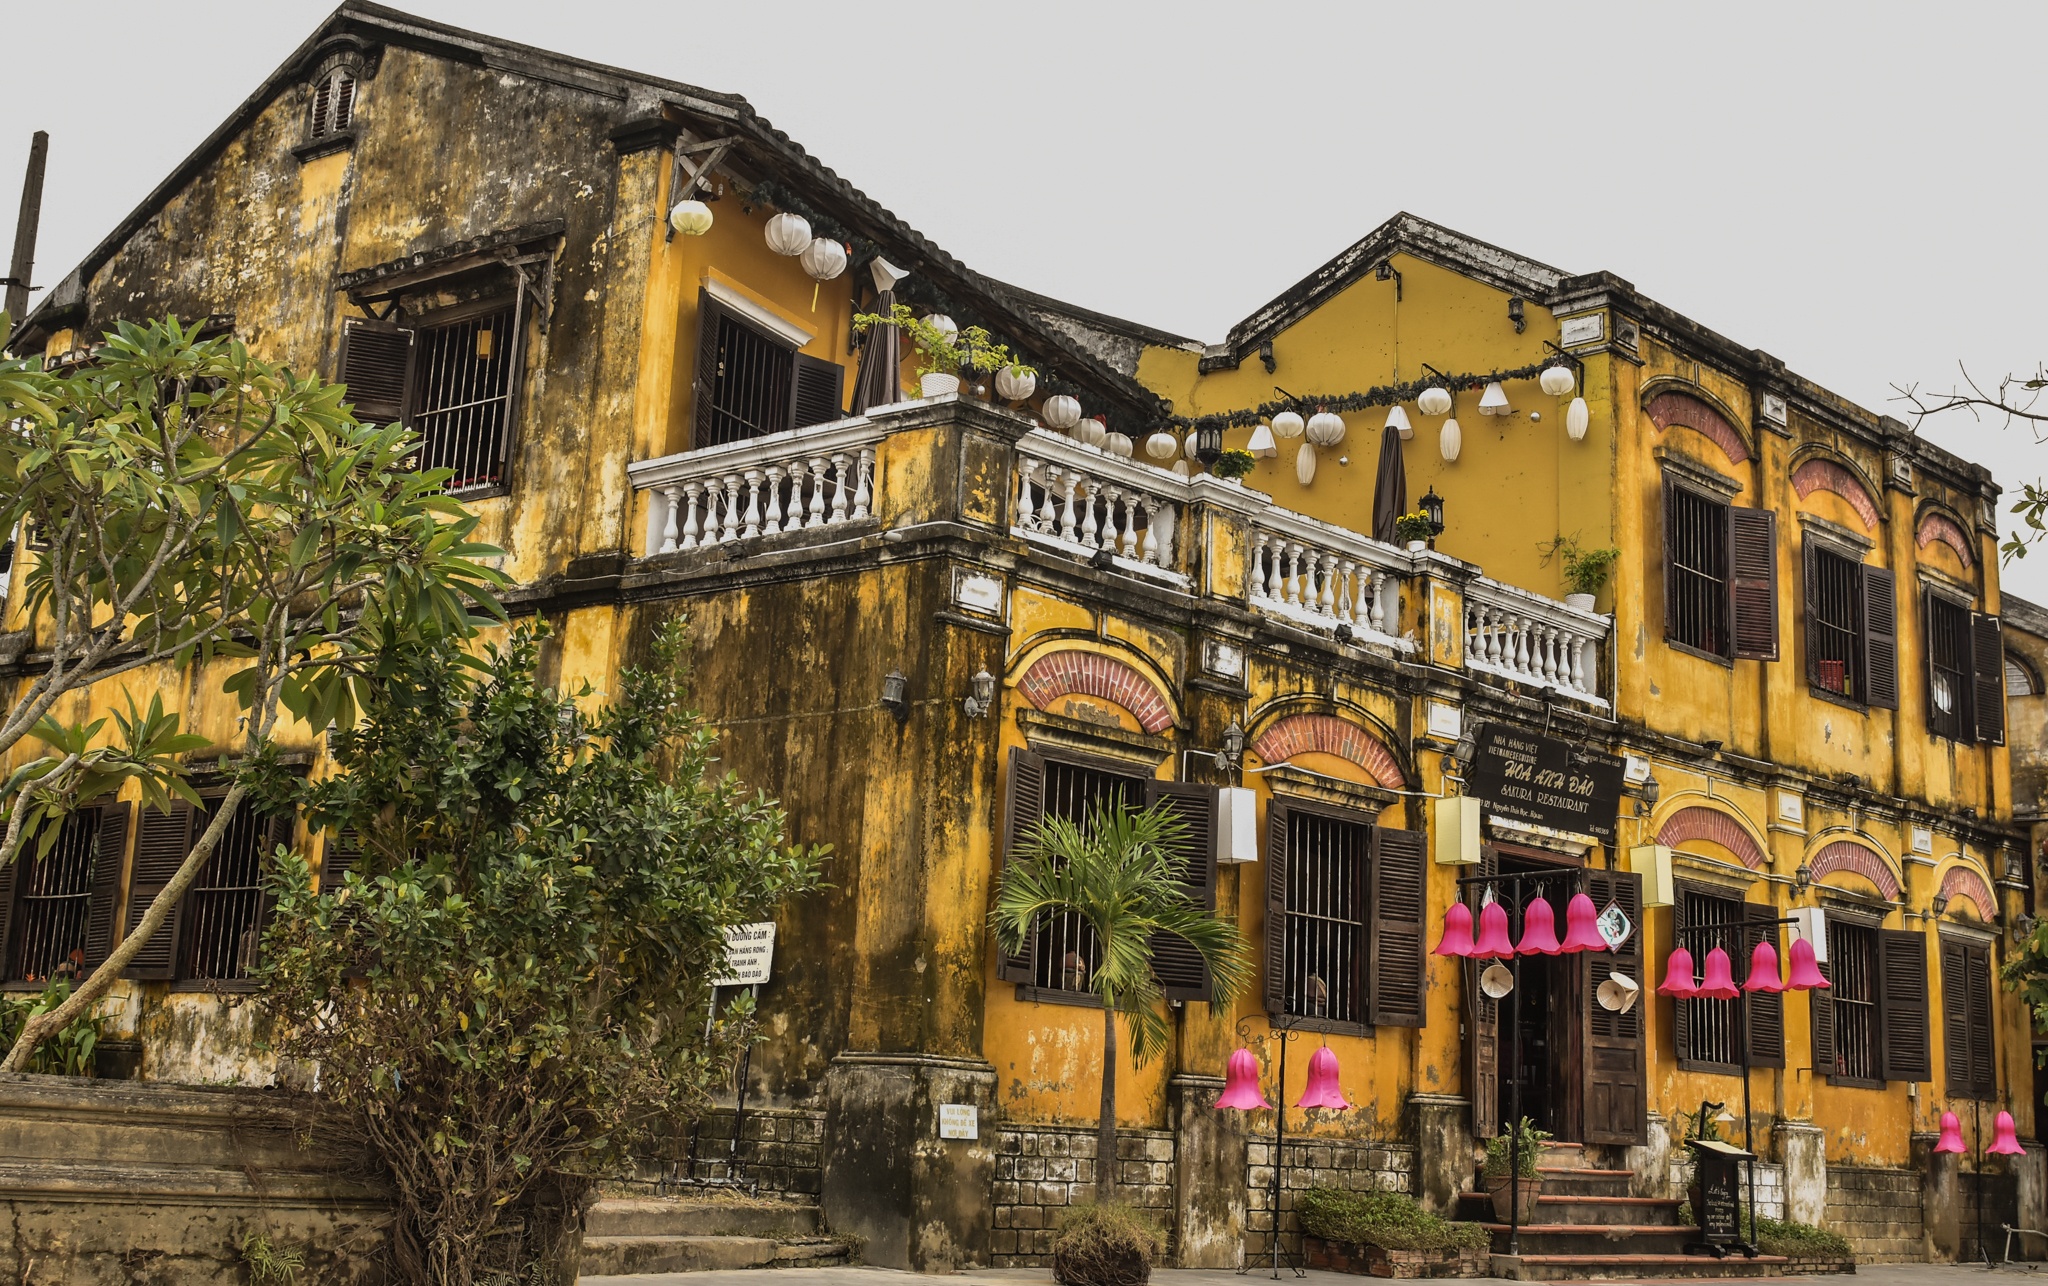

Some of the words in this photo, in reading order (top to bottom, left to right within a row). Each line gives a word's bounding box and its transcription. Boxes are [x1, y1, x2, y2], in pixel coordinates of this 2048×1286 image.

[1508, 737, 1525, 751] HÀNG
[1525, 742, 1538, 755] VIỆT
[1504, 760, 1533, 781] HOA
[1533, 769, 1566, 790] ANH
[1568, 774, 1595, 797] ĐÀO
[1500, 784, 1532, 801] SAKURA
[1536, 792, 1590, 814] RESTAURANT
